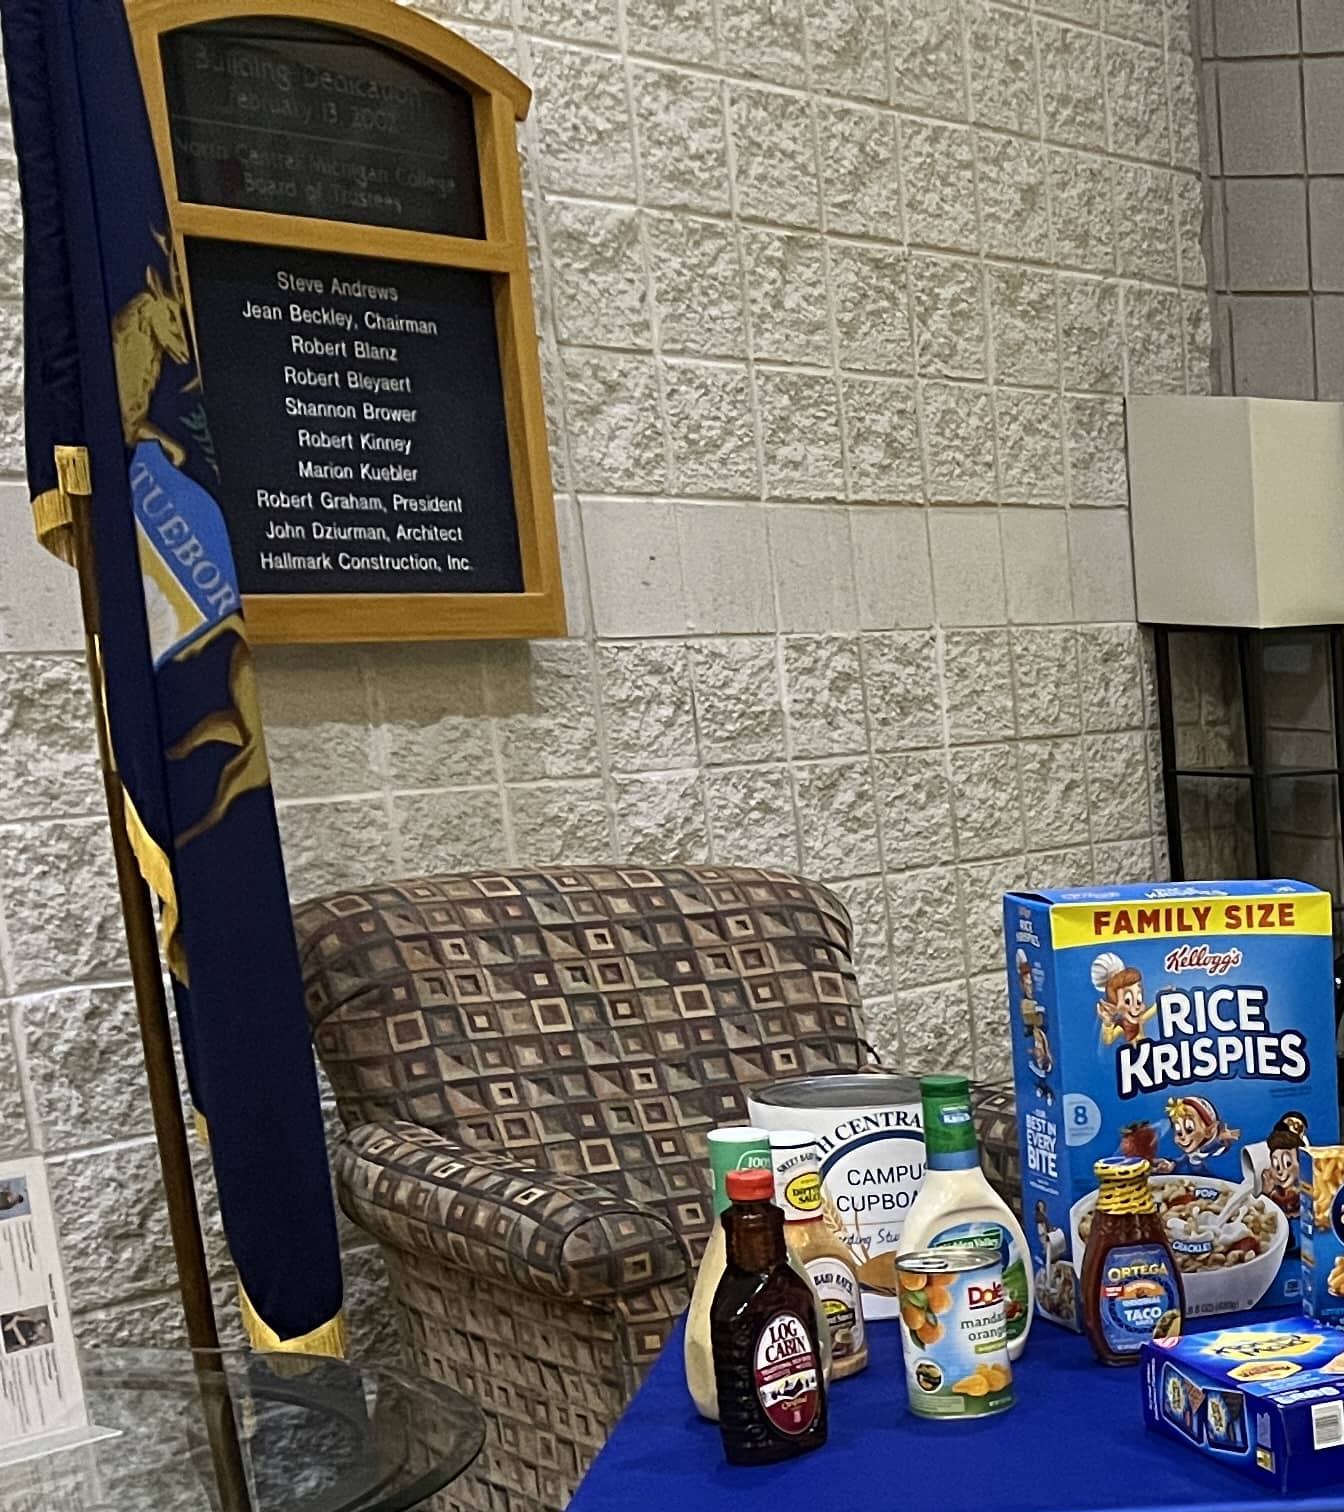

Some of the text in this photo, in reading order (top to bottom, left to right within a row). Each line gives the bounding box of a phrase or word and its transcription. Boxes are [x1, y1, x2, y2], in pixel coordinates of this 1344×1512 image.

[277, 271, 398, 301] Steve Andrews
[242, 301, 437, 335] Jean Beckley, Chairman
[291, 335, 397, 361] Robert Blanz
[284, 366, 411, 393] Robert Bleyaert
[285, 397, 416, 423] Shannon Brower
[298, 430, 412, 456] Robert Kinney
[298, 461, 418, 482] Marion Kuebler
[256, 489, 462, 514] Robert Graham, President
[131, 462, 236, 616] TUEBOR
[265, 522, 462, 542] John Dziurman, Architect
[260, 552, 333, 571] Hallmark
[338, 553, 441, 573] Construction,
[1093, 903, 1296, 936] FAMILY SIZE
[1165, 945, 1242, 975] Kellogg's
[1159, 990, 1264, 1038] RICE
[1121, 1033, 1307, 1094] KRISPIES
[834, 1110, 924, 1142] CENTRA
[1074, 1105, 1088, 1125] 8
[1026, 1128, 1057, 1153] EVERY
[1027, 1145, 1058, 1178] BITE
[1107, 1263, 1169, 1283] ORTEGA
[968, 1281, 1004, 1307] Dole
[1124, 1306, 1162, 1322] TACO
[768, 1319, 798, 1344] LOG
[765, 1336, 807, 1363] CABIN
